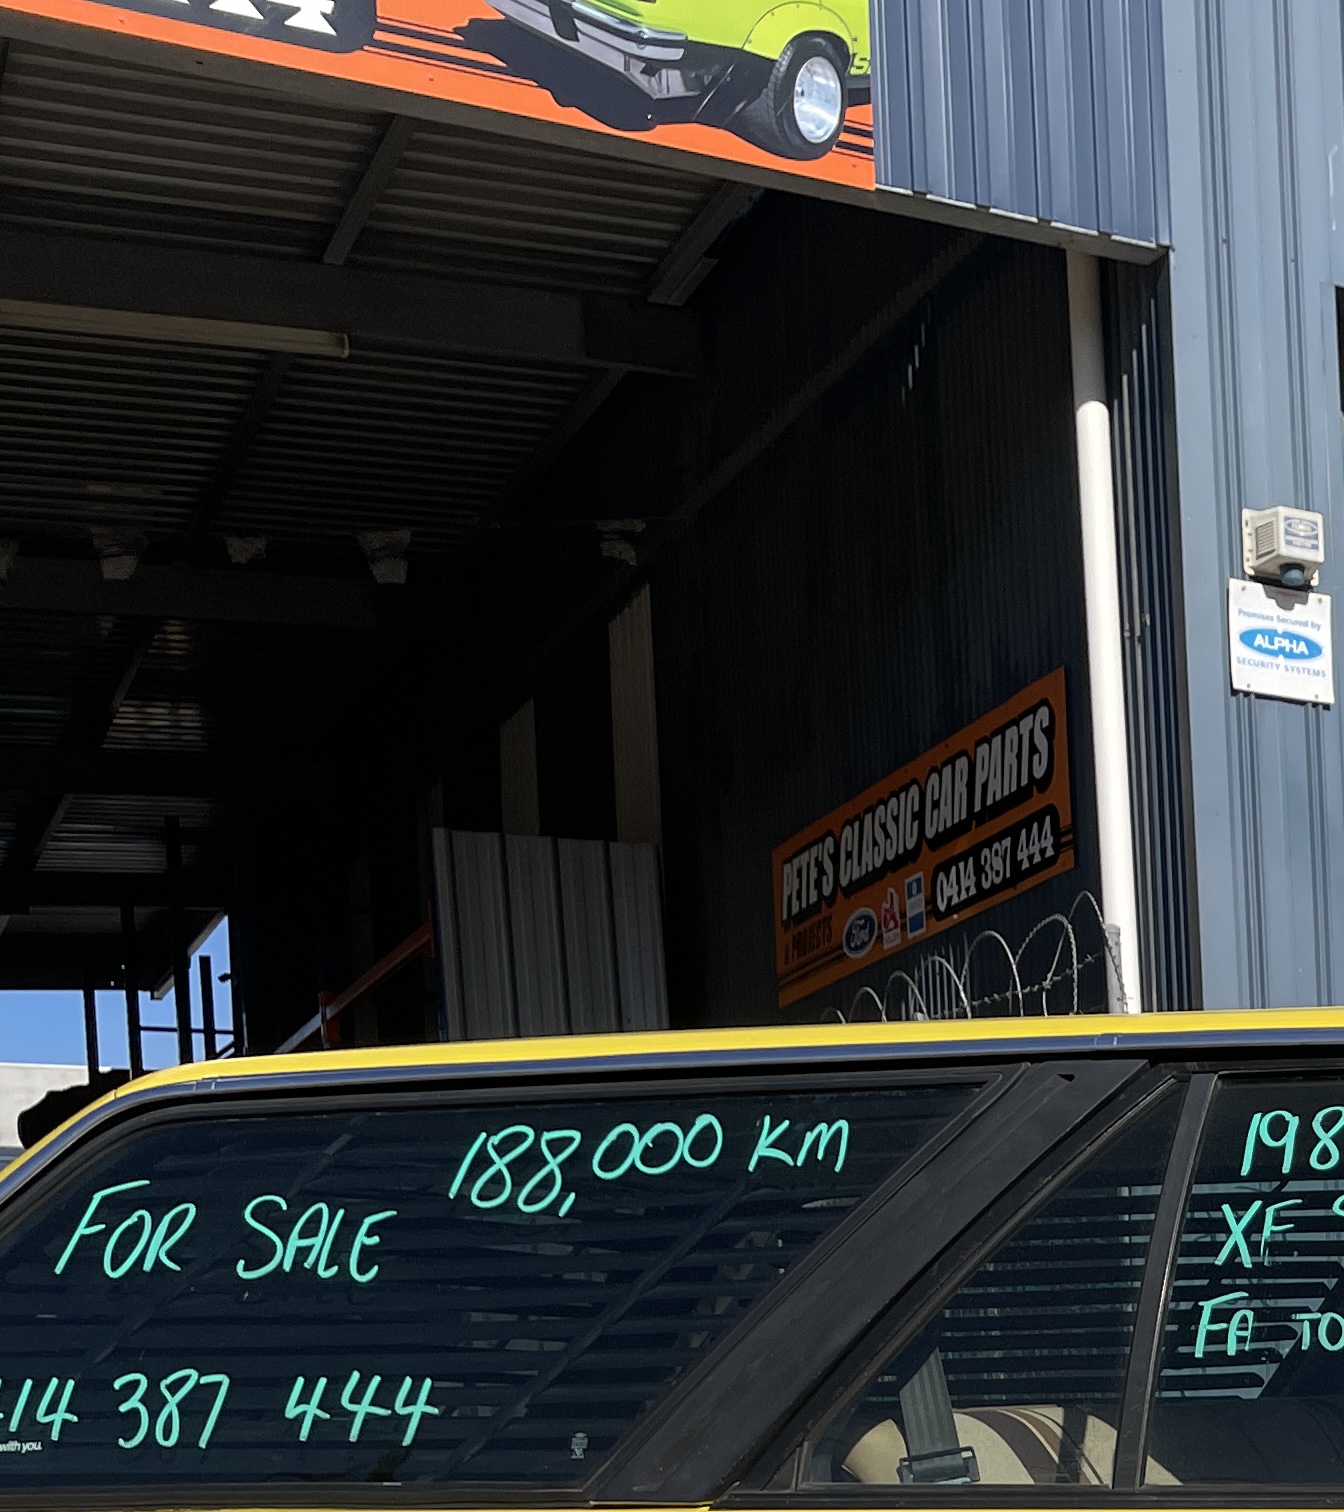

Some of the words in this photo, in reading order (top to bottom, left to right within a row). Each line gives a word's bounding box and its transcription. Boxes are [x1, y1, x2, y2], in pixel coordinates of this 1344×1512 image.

[1237, 608, 1274, 622] Premises
[1277, 615, 1309, 628] Secured
[1311, 621, 1321, 632] by
[1253, 633, 1309, 656] ALPHA
[1236, 656, 1281, 671] SECURITY
[1284, 664, 1326, 678] SYSTEMS
[782, 835, 834, 922] PETE'S
[838, 783, 919, 889] CLASSIC
[924, 754, 968, 840] CAR
[974, 705, 1050, 814] PARTS
[936, 860, 977, 914] 0414
[981, 837, 1011, 891] 387
[1016, 814, 1055, 871] 444
[448, 1113, 724, 1217] 188,000
[54, 1179, 196, 1279] FOR
[236, 1194, 398, 1283] SALE
[1213, 1198, 1303, 1268] XF
[0, 1378, 79, 1442] 14
[112, 1368, 230, 1450] 387
[284, 1370, 440, 1447] 444
